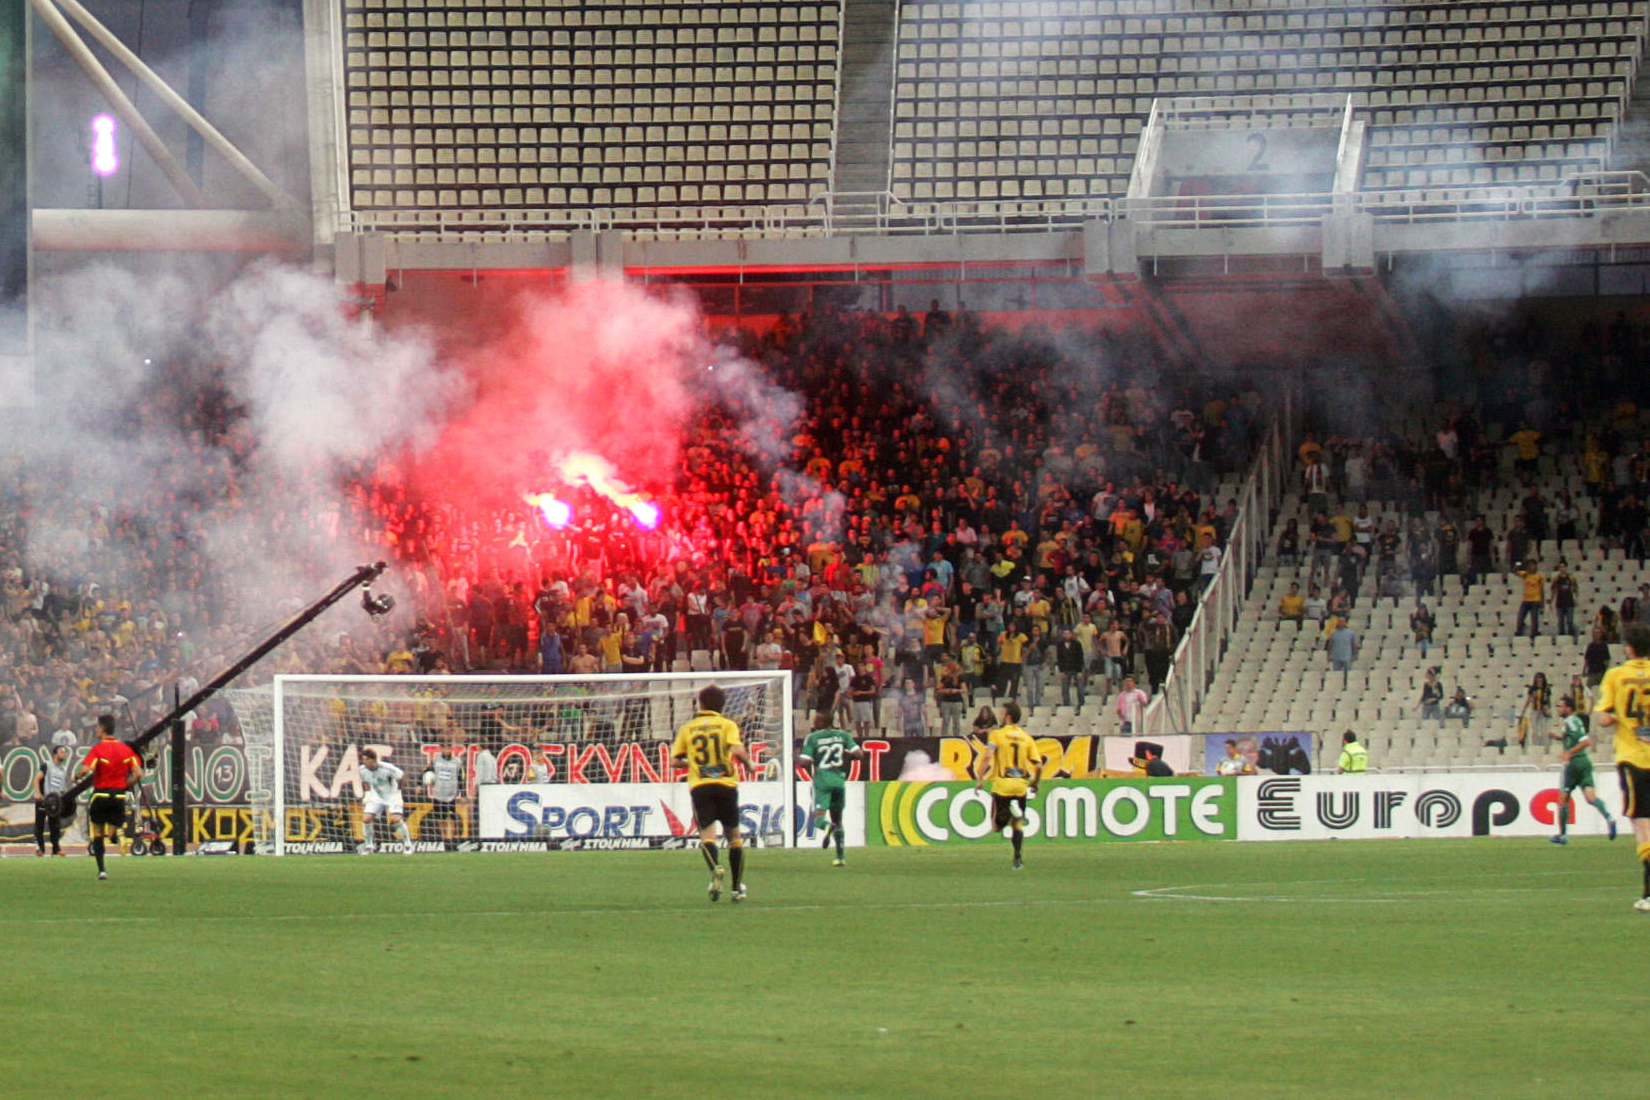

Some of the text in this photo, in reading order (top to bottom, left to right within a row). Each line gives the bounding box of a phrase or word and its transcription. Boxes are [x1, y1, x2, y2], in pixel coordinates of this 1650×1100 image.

[1246, 132, 1270, 171] 2
[692, 733, 721, 766] 31
[817, 743, 844, 769] 23
[1010, 742, 1019, 767] 1
